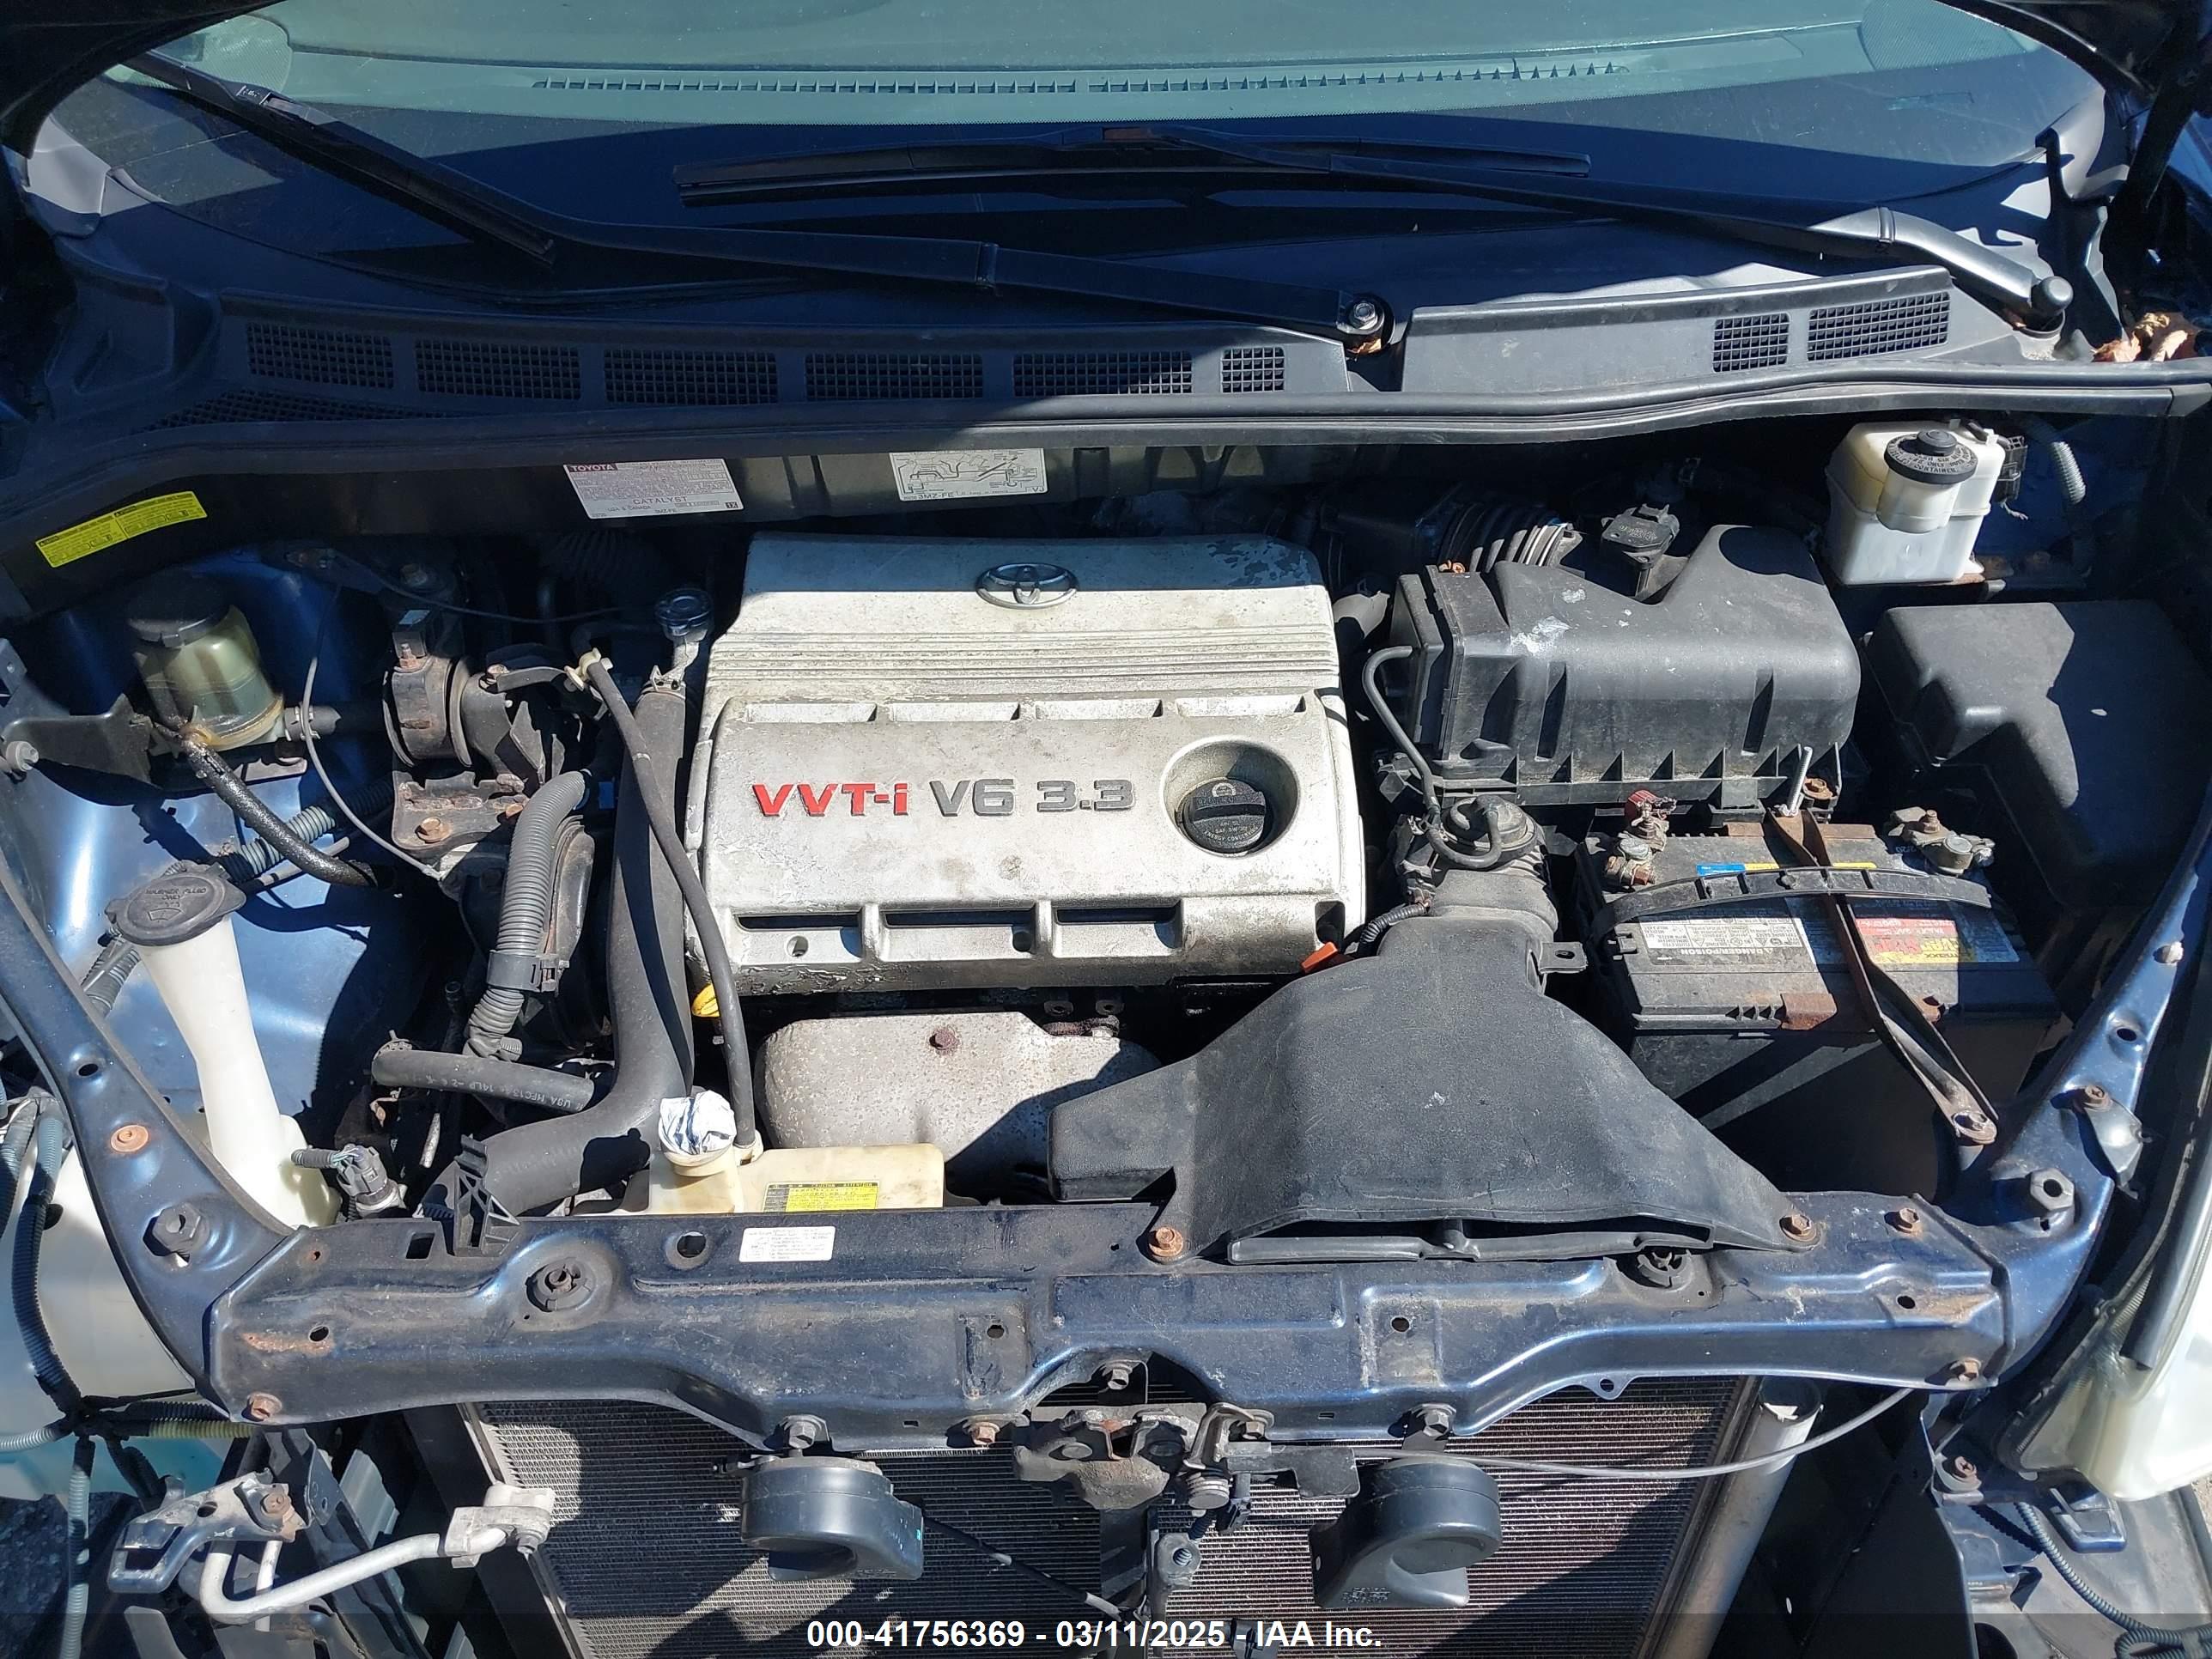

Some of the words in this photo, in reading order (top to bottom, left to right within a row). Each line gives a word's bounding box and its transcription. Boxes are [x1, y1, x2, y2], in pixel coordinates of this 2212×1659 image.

[633, 496, 688, 505] CATALYST
[751, 781, 908, 817] VVT-i
[929, 778, 1016, 817] V6
[1036, 778, 1136, 812] 3.3
[550, 1096, 571, 1108] USA
